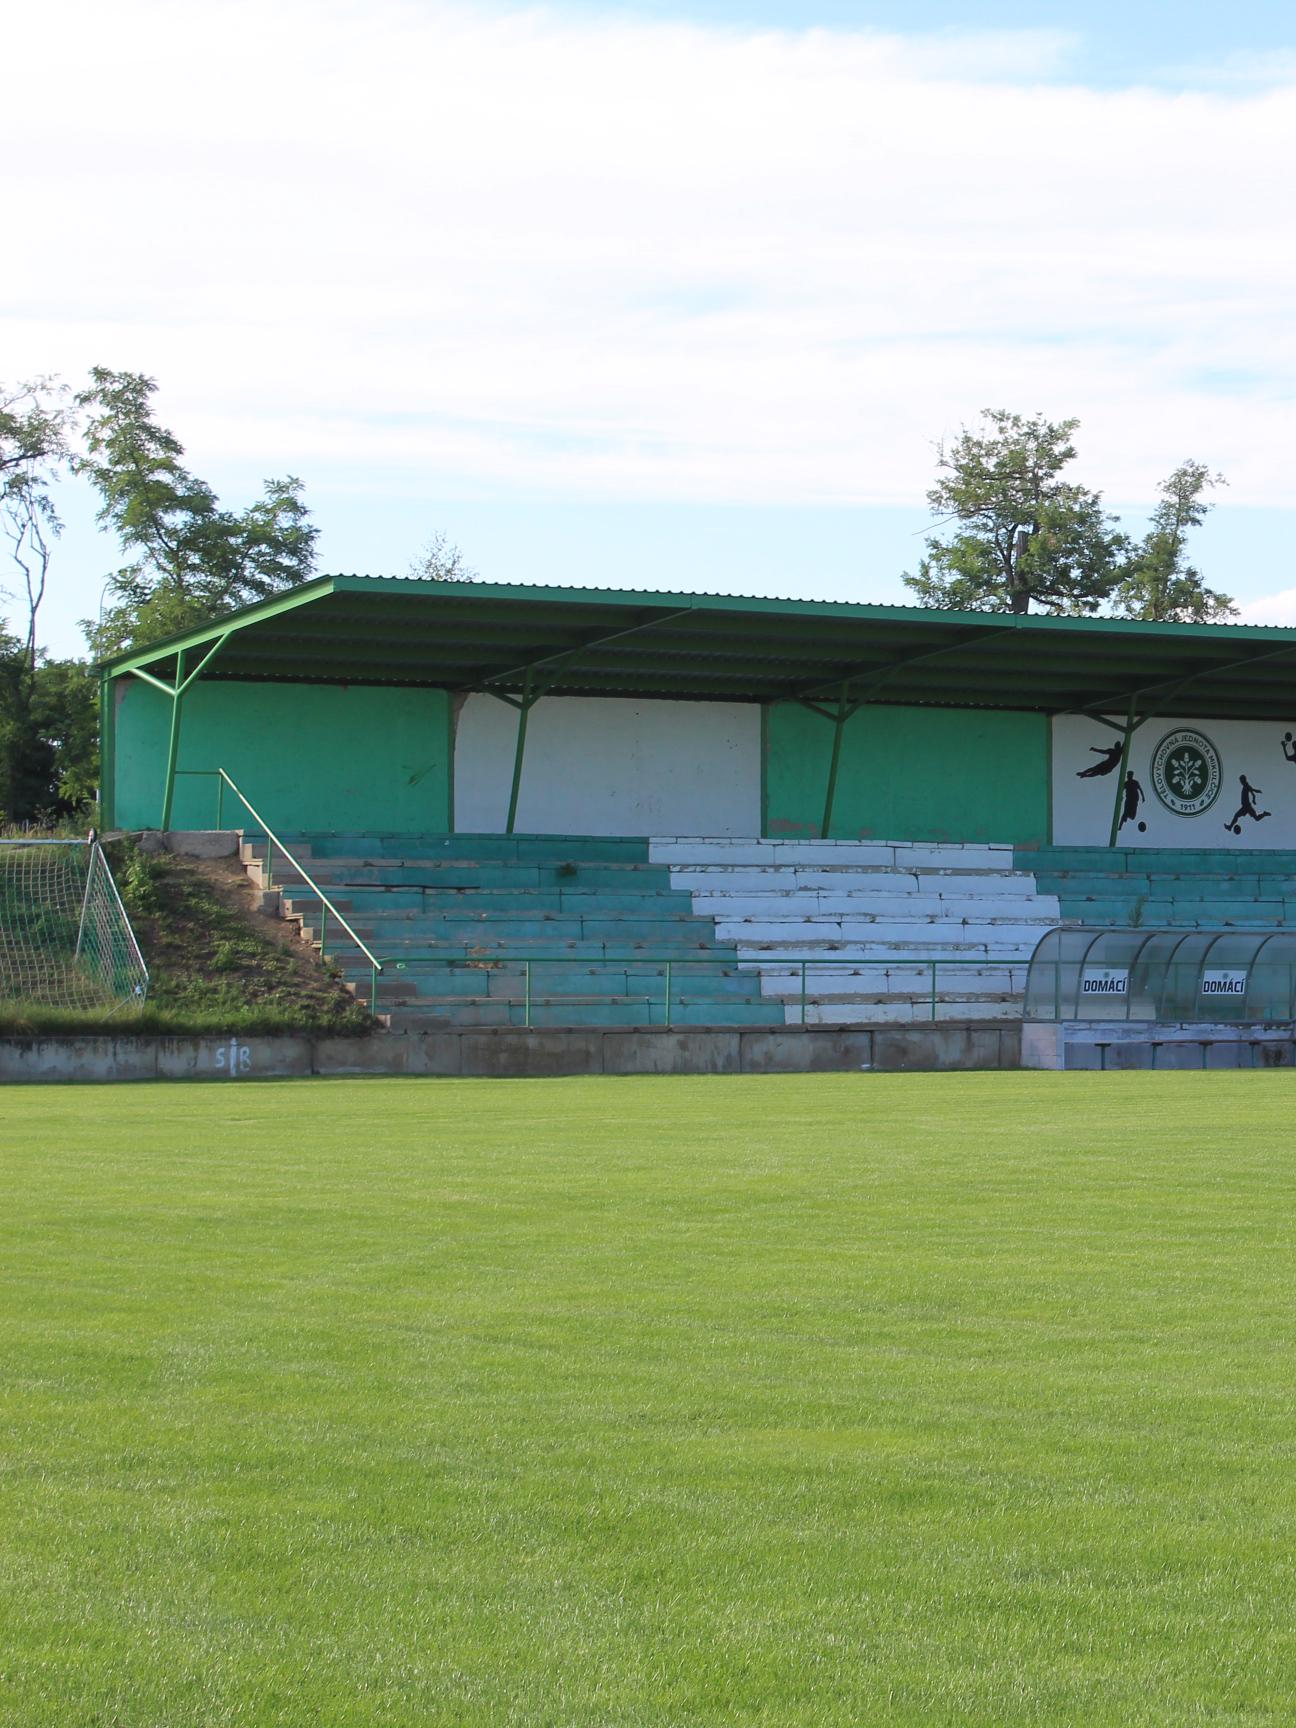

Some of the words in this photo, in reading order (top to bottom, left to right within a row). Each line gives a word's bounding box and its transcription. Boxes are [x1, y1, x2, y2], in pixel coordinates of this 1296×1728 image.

[1181, 735, 1211, 755] JEDNOTA
[1083, 977, 1127, 992] DOMÁCÍ
[1203, 978, 1246, 993] DOMÁCÍ
